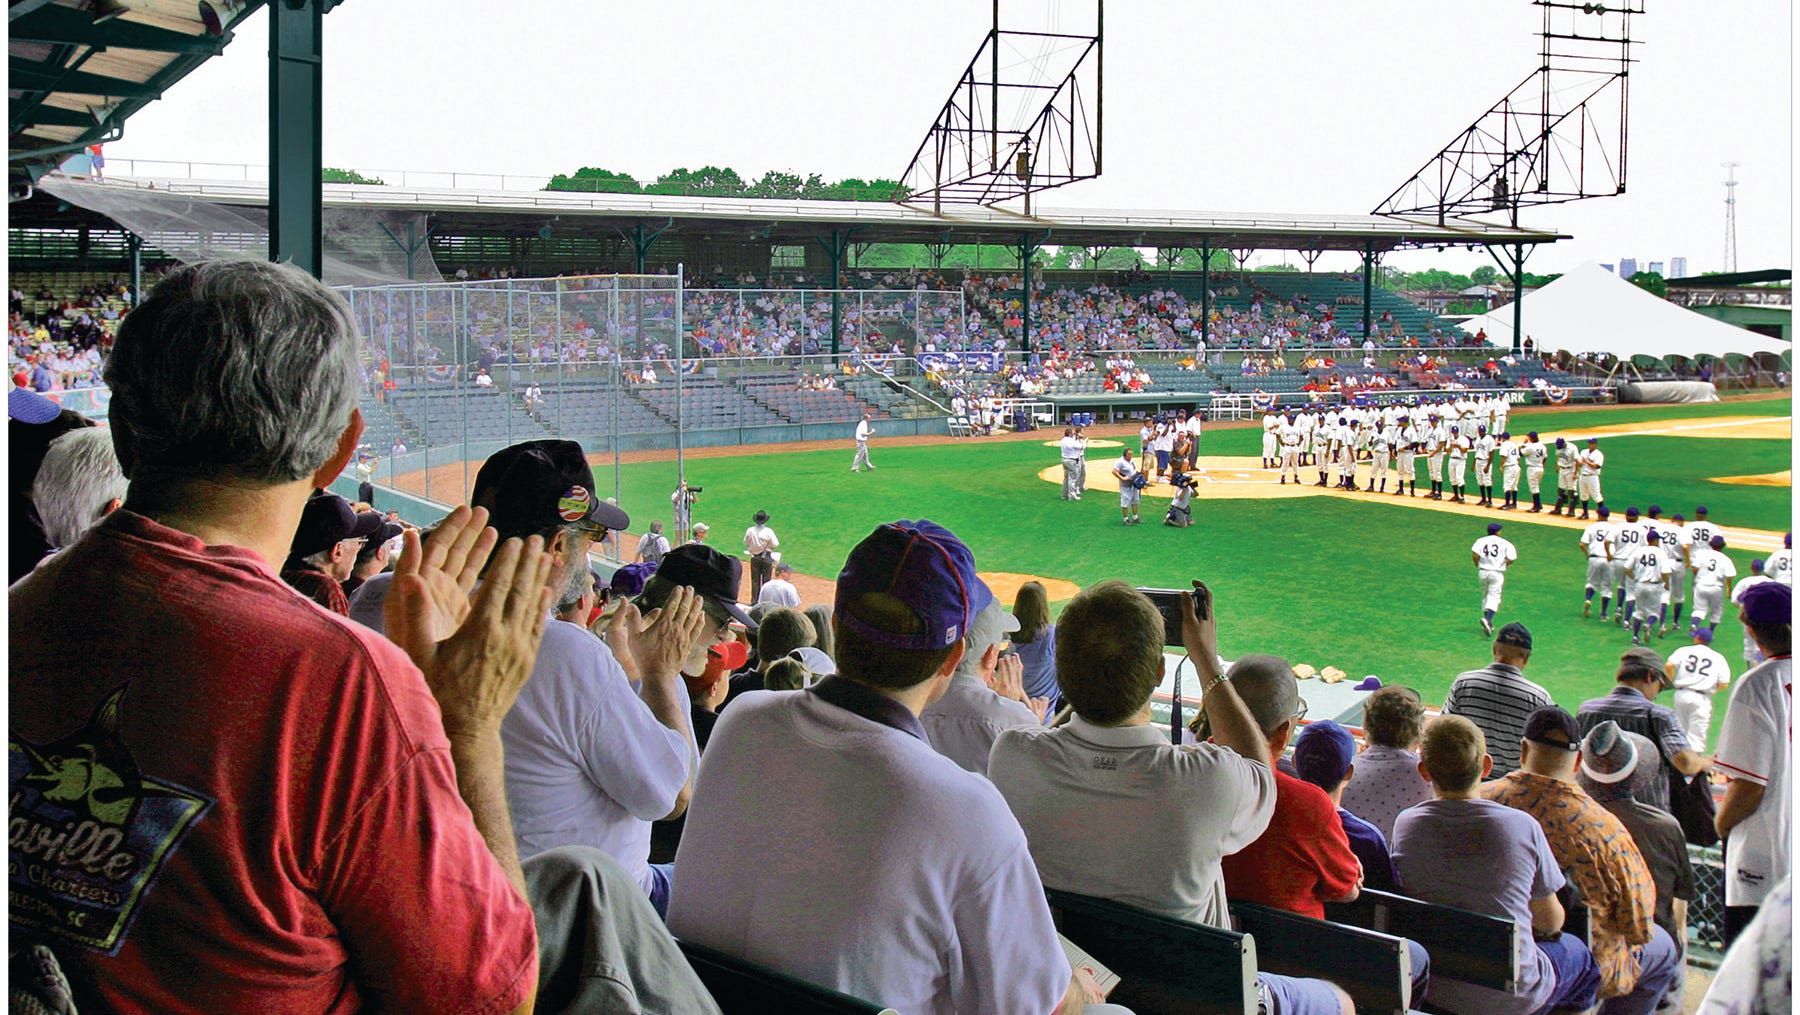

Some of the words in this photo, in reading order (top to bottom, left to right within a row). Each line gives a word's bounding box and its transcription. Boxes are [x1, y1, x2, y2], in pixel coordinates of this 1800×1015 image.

[1621, 529, 1639, 544] 50
[1662, 530, 1677, 545] 28
[1692, 527, 1710, 542] 36
[1482, 543, 1499, 558] 43
[1639, 553, 1656, 567] 48
[1707, 558, 1717, 572] 3
[1779, 556, 1792, 571] 3
[1685, 654, 1713, 677] 32
[66, 909, 89, 929] SC
